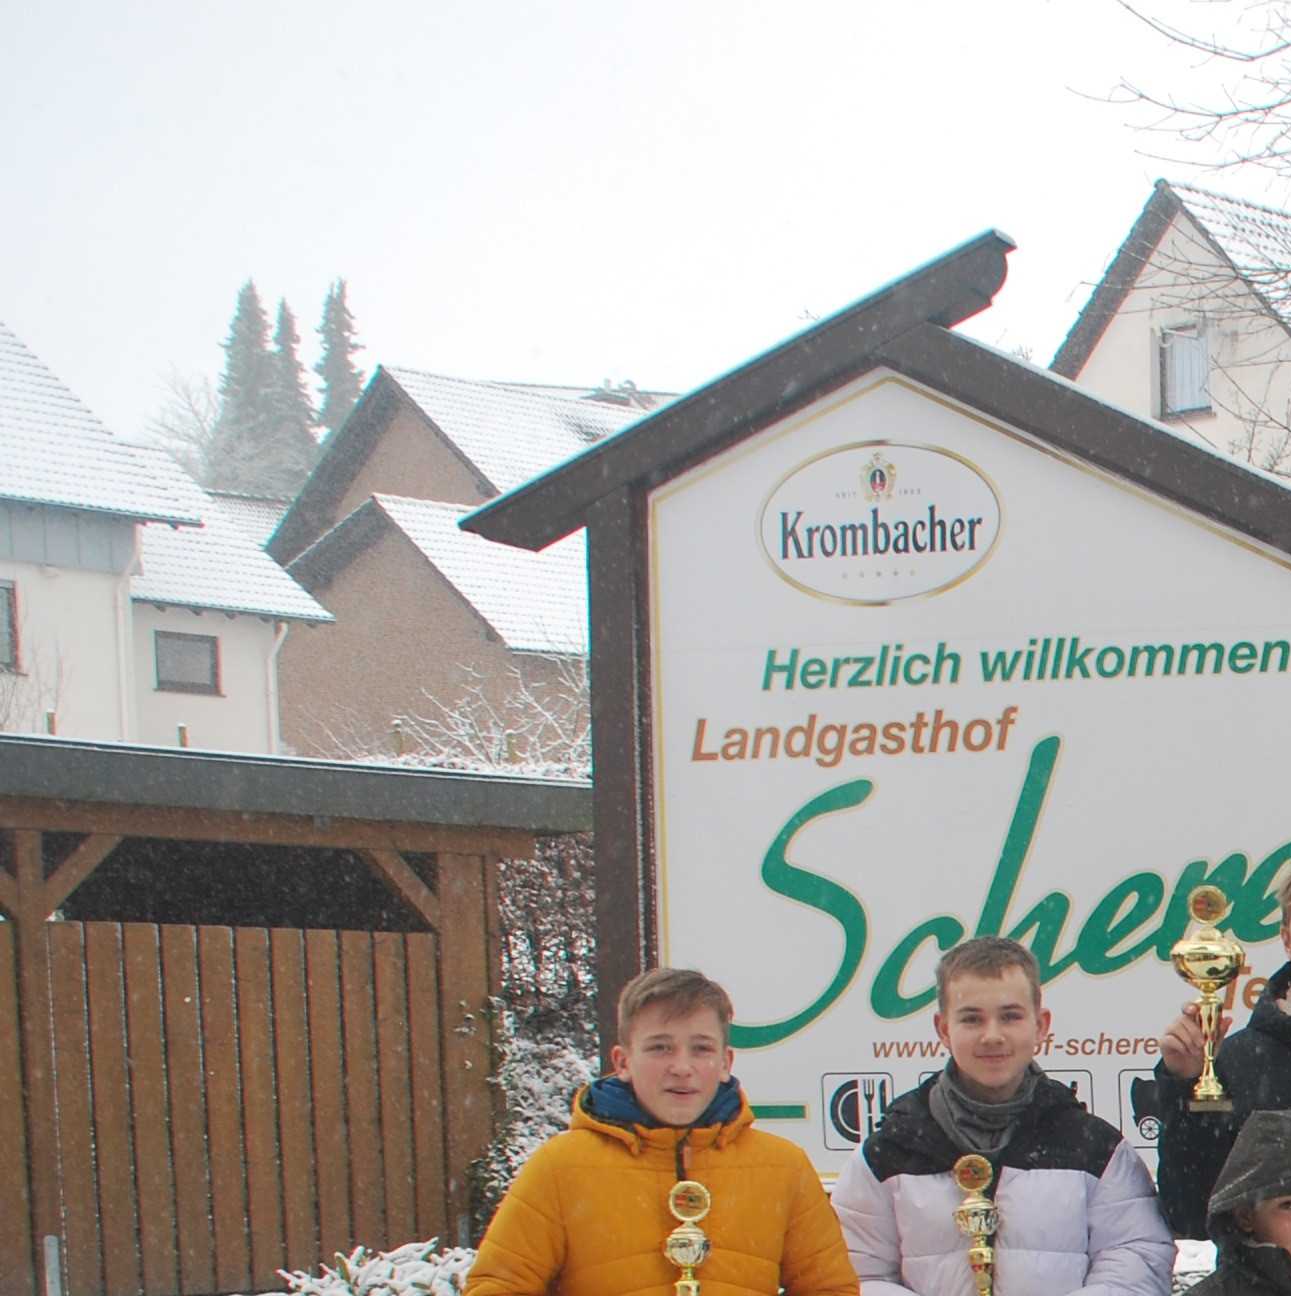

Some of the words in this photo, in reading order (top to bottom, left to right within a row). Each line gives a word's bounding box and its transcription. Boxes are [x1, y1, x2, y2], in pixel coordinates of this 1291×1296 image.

[780, 505, 983, 560] Krombacher
[761, 642, 961, 691] Herzlich
[691, 705, 1019, 768] Landgasthof
